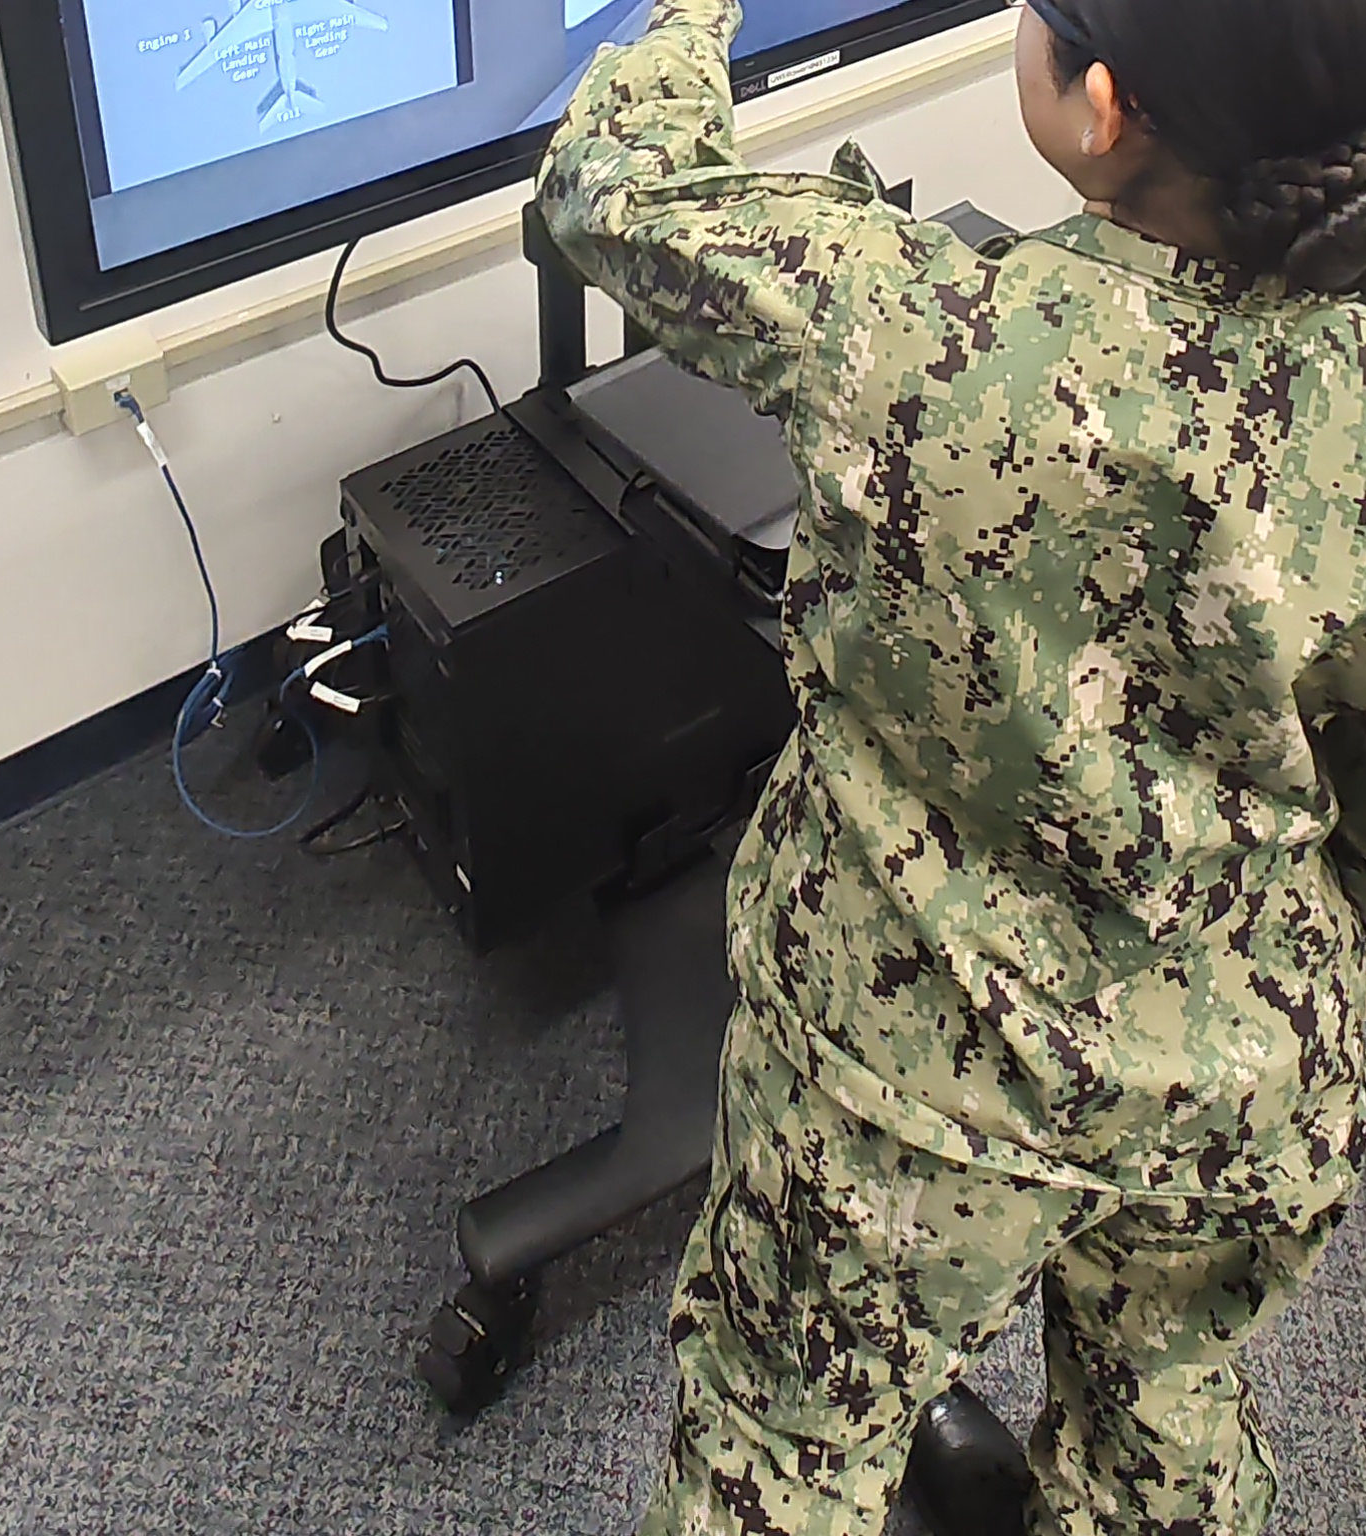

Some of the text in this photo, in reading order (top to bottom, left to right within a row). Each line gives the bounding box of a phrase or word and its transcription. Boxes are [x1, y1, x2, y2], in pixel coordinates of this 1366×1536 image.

[295, 14, 356, 38] Right Main
[138, 28, 192, 53] Engine 1
[214, 36, 272, 61] Left Main
[304, 29, 349, 49] Landing
[314, 43, 341, 58] Gear
[221, 52, 267, 73] Landing
[232, 67, 260, 83] Gear
[740, 78, 767, 98] DELL
[276, 106, 302, 123] Tail
